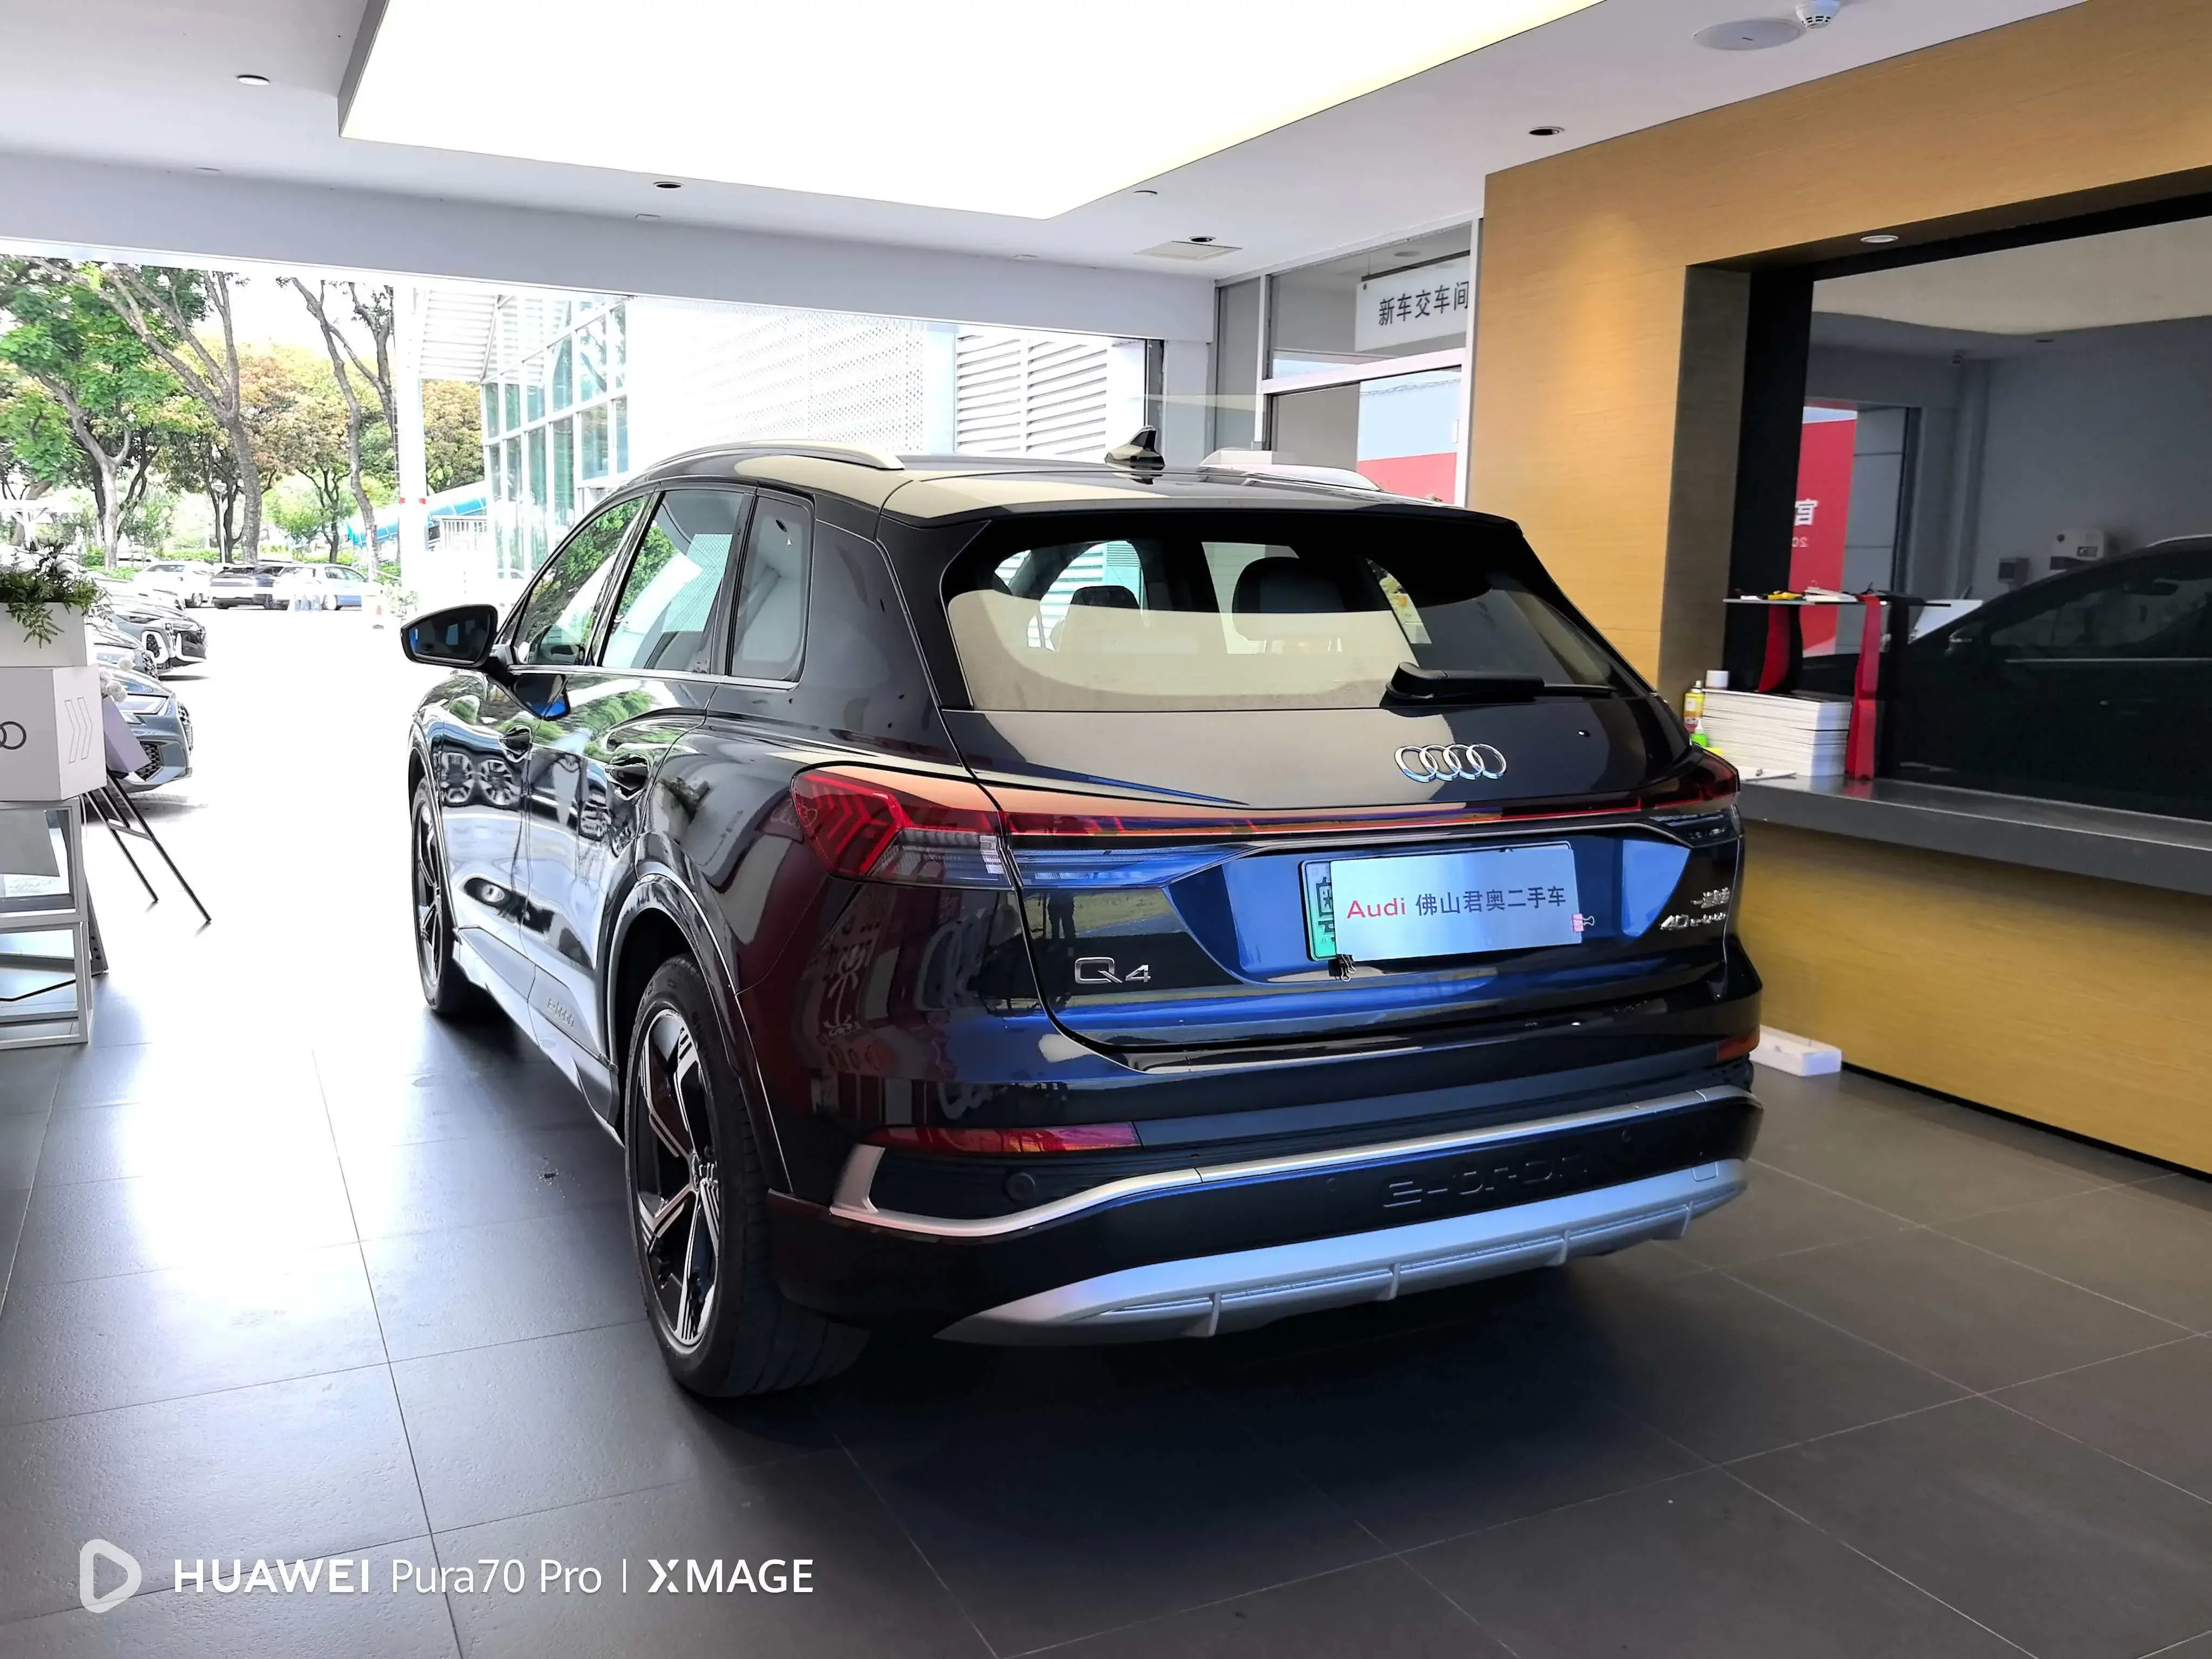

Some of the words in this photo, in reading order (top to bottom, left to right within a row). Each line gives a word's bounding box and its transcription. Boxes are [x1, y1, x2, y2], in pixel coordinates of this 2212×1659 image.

[1379, 281, 1469, 326] 新车交车间
[1347, 897, 1406, 919] Audi
[1415, 885, 1567, 916] 佛山君奥二手车
[1074, 956, 1151, 983] Q4
